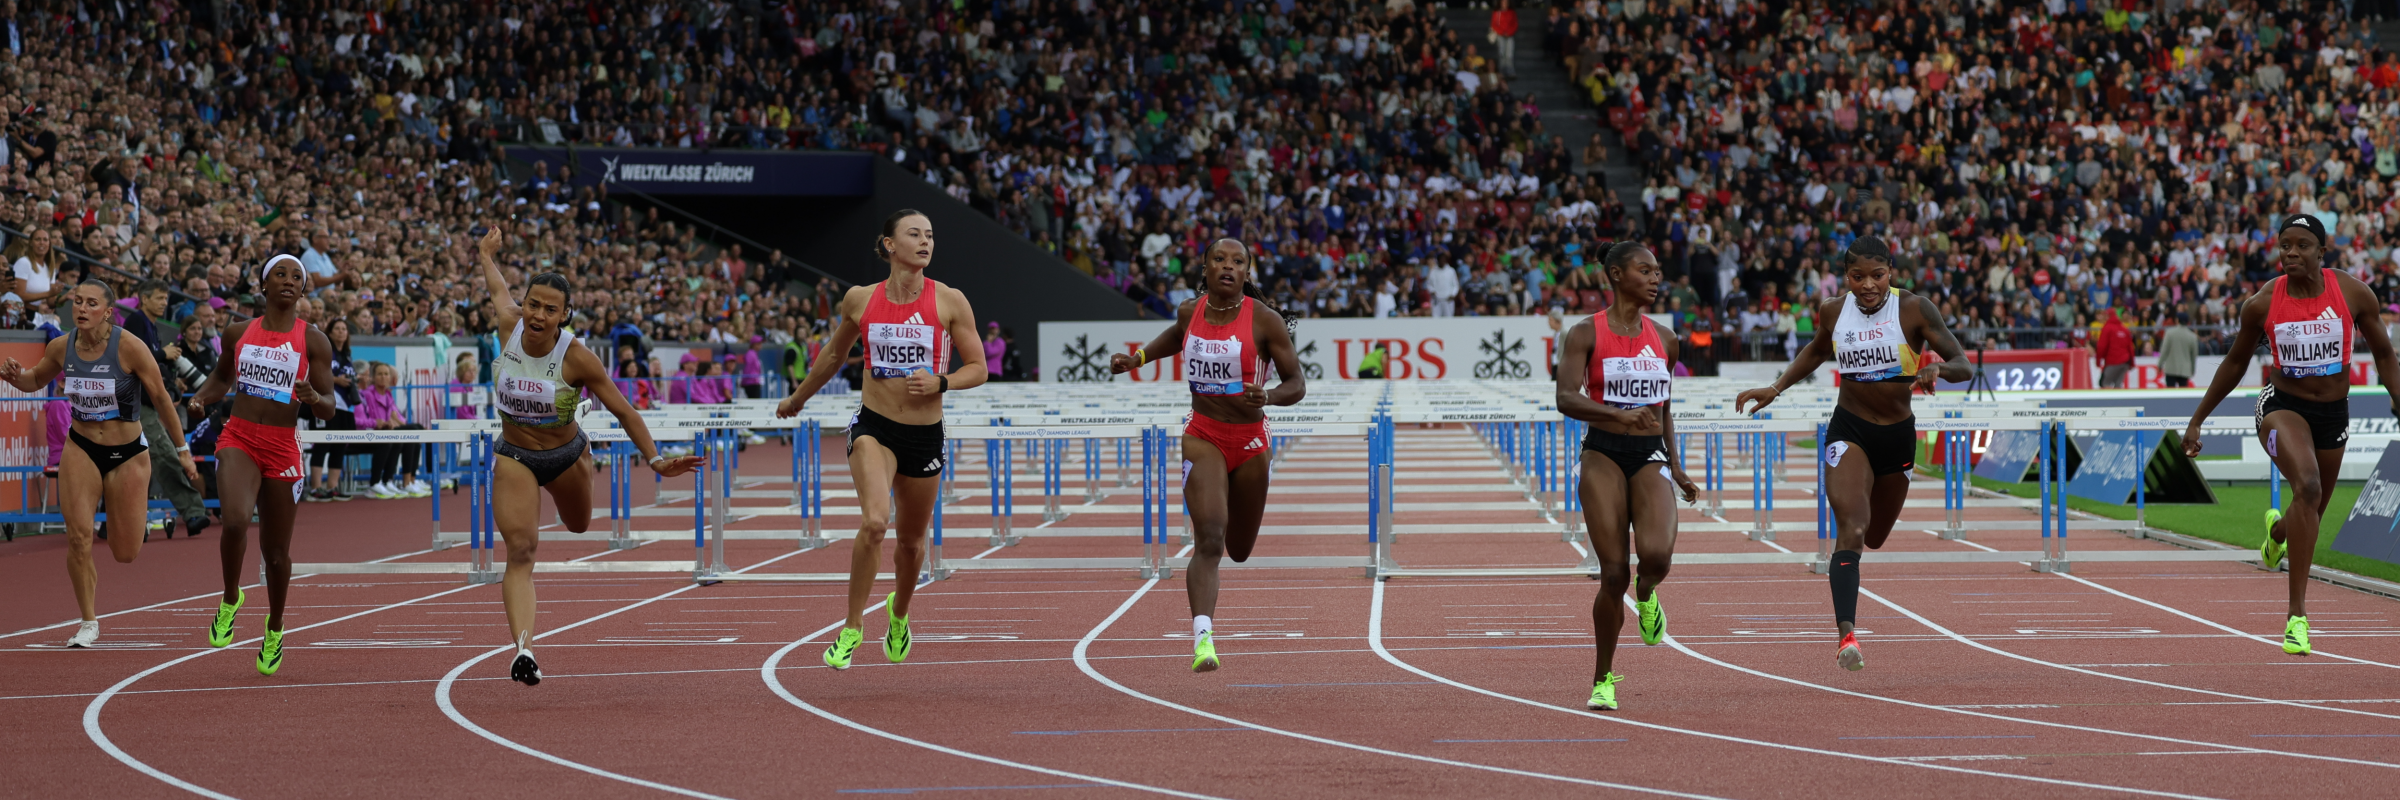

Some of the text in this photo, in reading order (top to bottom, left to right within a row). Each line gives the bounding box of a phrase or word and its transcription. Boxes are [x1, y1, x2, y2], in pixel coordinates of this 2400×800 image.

[621, 161, 754, 182] WELTKLASSE ZÜRICH
[895, 327, 922, 339] UBS
[1858, 328, 1884, 341] UBS
[2302, 323, 2331, 335] UBS
[876, 345, 926, 363] VISSER
[1205, 343, 1229, 354] UBS
[2279, 341, 2340, 361] WILLIAMS
[265, 349, 289, 362] UBS
[504, 352, 522, 364] visana
[1333, 337, 1447, 380] UBS
[1838, 346, 1897, 369] MARSHALL
[1189, 358, 1232, 379] STARK
[1632, 360, 1660, 371] UBS
[2294, 366, 2327, 376] ZURICH
[240, 362, 294, 388] HARRISON
[1996, 367, 2062, 391] 12.29
[84, 381, 105, 391] UBS
[246, 385, 275, 398] ZURICH
[518, 380, 543, 393] UBS
[1196, 383, 1226, 393] ZURICH
[1607, 379, 1668, 398] NUGENT
[499, 390, 553, 414] KAMBUNDJI
[1488, 412, 1516, 420] ZÜRICH
[2060, 409, 2087, 417] ZÜRICH
[725, 419, 752, 427] ZÜRICH
[1107, 416, 1134, 424] ZÜRICH
[1830, 446, 1837, 459] 3
